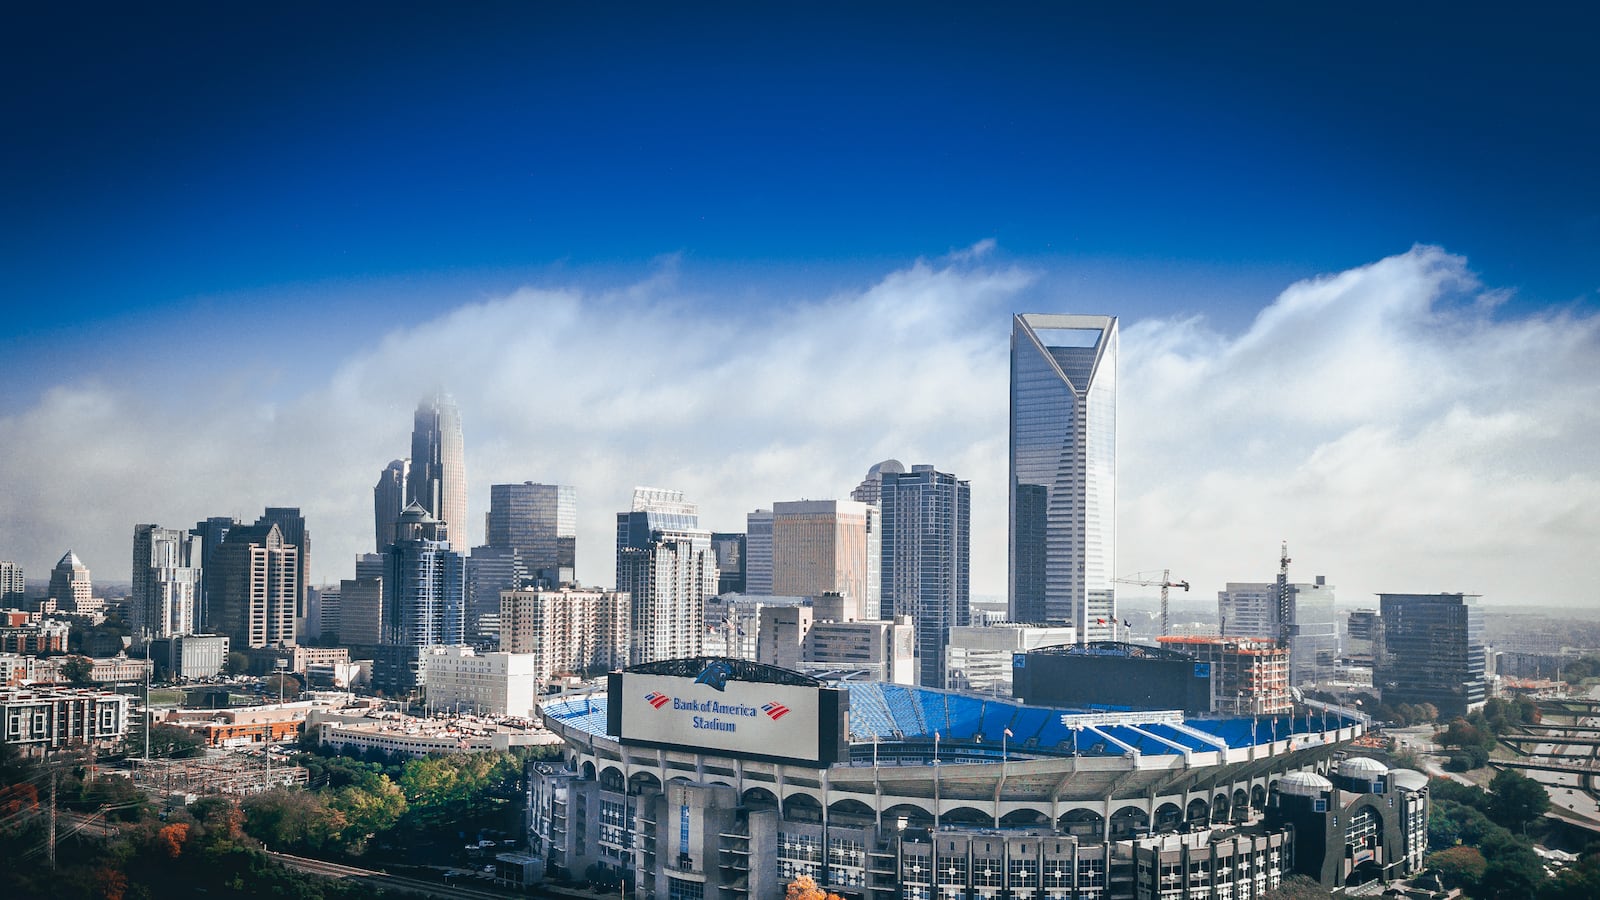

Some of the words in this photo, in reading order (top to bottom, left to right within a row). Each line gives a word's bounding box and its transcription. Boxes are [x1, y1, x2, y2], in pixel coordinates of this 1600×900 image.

[673, 697, 698, 710] Bank
[700, 700, 711, 712] of
[712, 701, 757, 717] America
[693, 716, 736, 732] Stadium
